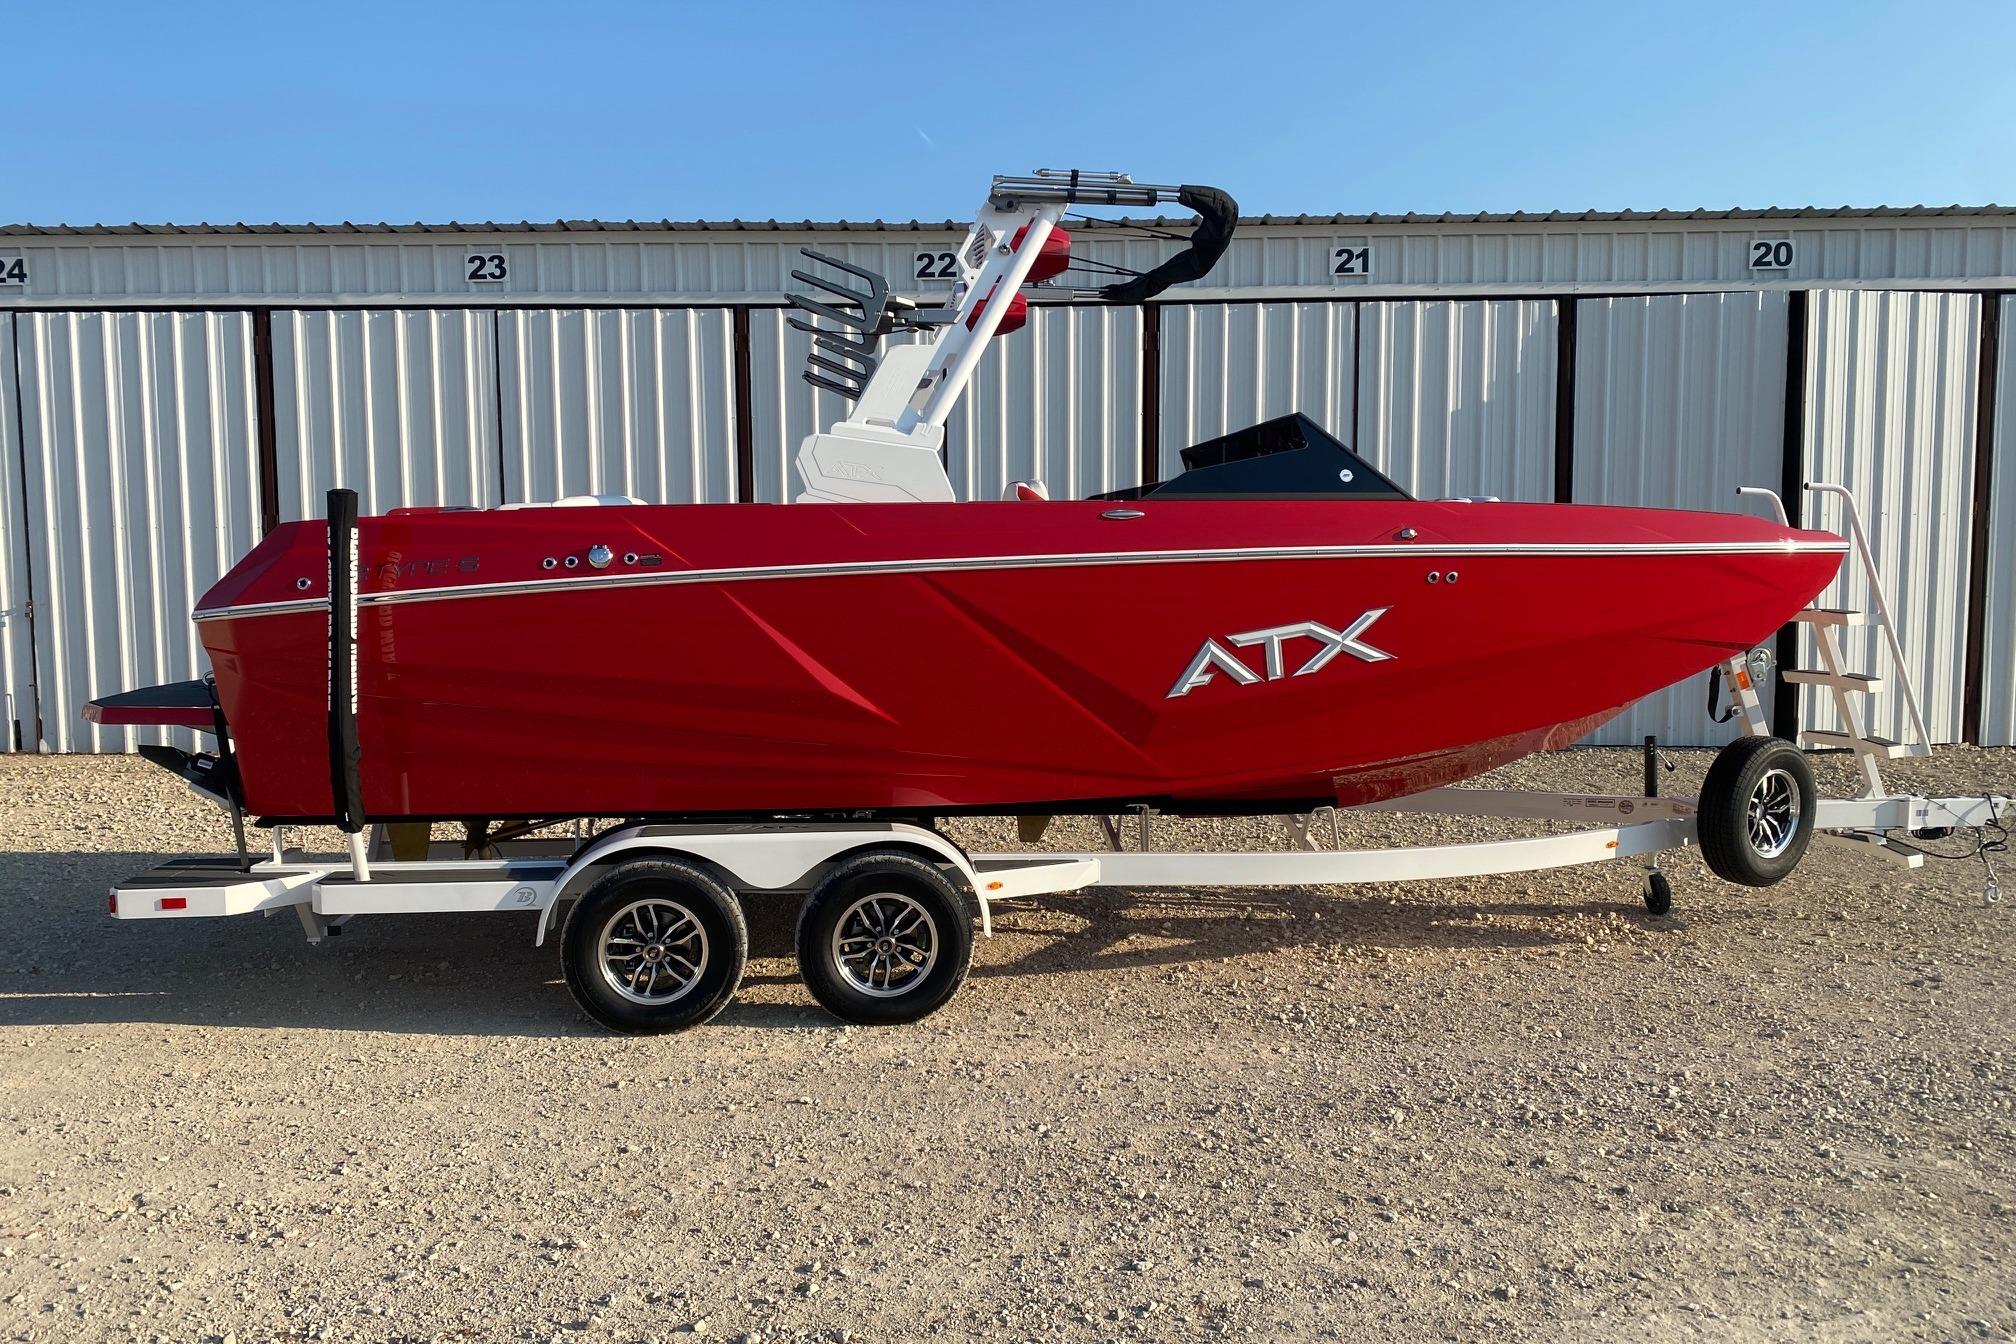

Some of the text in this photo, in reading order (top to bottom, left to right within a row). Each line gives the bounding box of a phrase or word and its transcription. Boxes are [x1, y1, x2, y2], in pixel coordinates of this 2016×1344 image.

[467, 254, 507, 280] 23
[916, 252, 958, 278] 22
[1334, 247, 1370, 273] 21
[1752, 241, 1794, 267] 20
[1165, 604, 1399, 699] ATX
